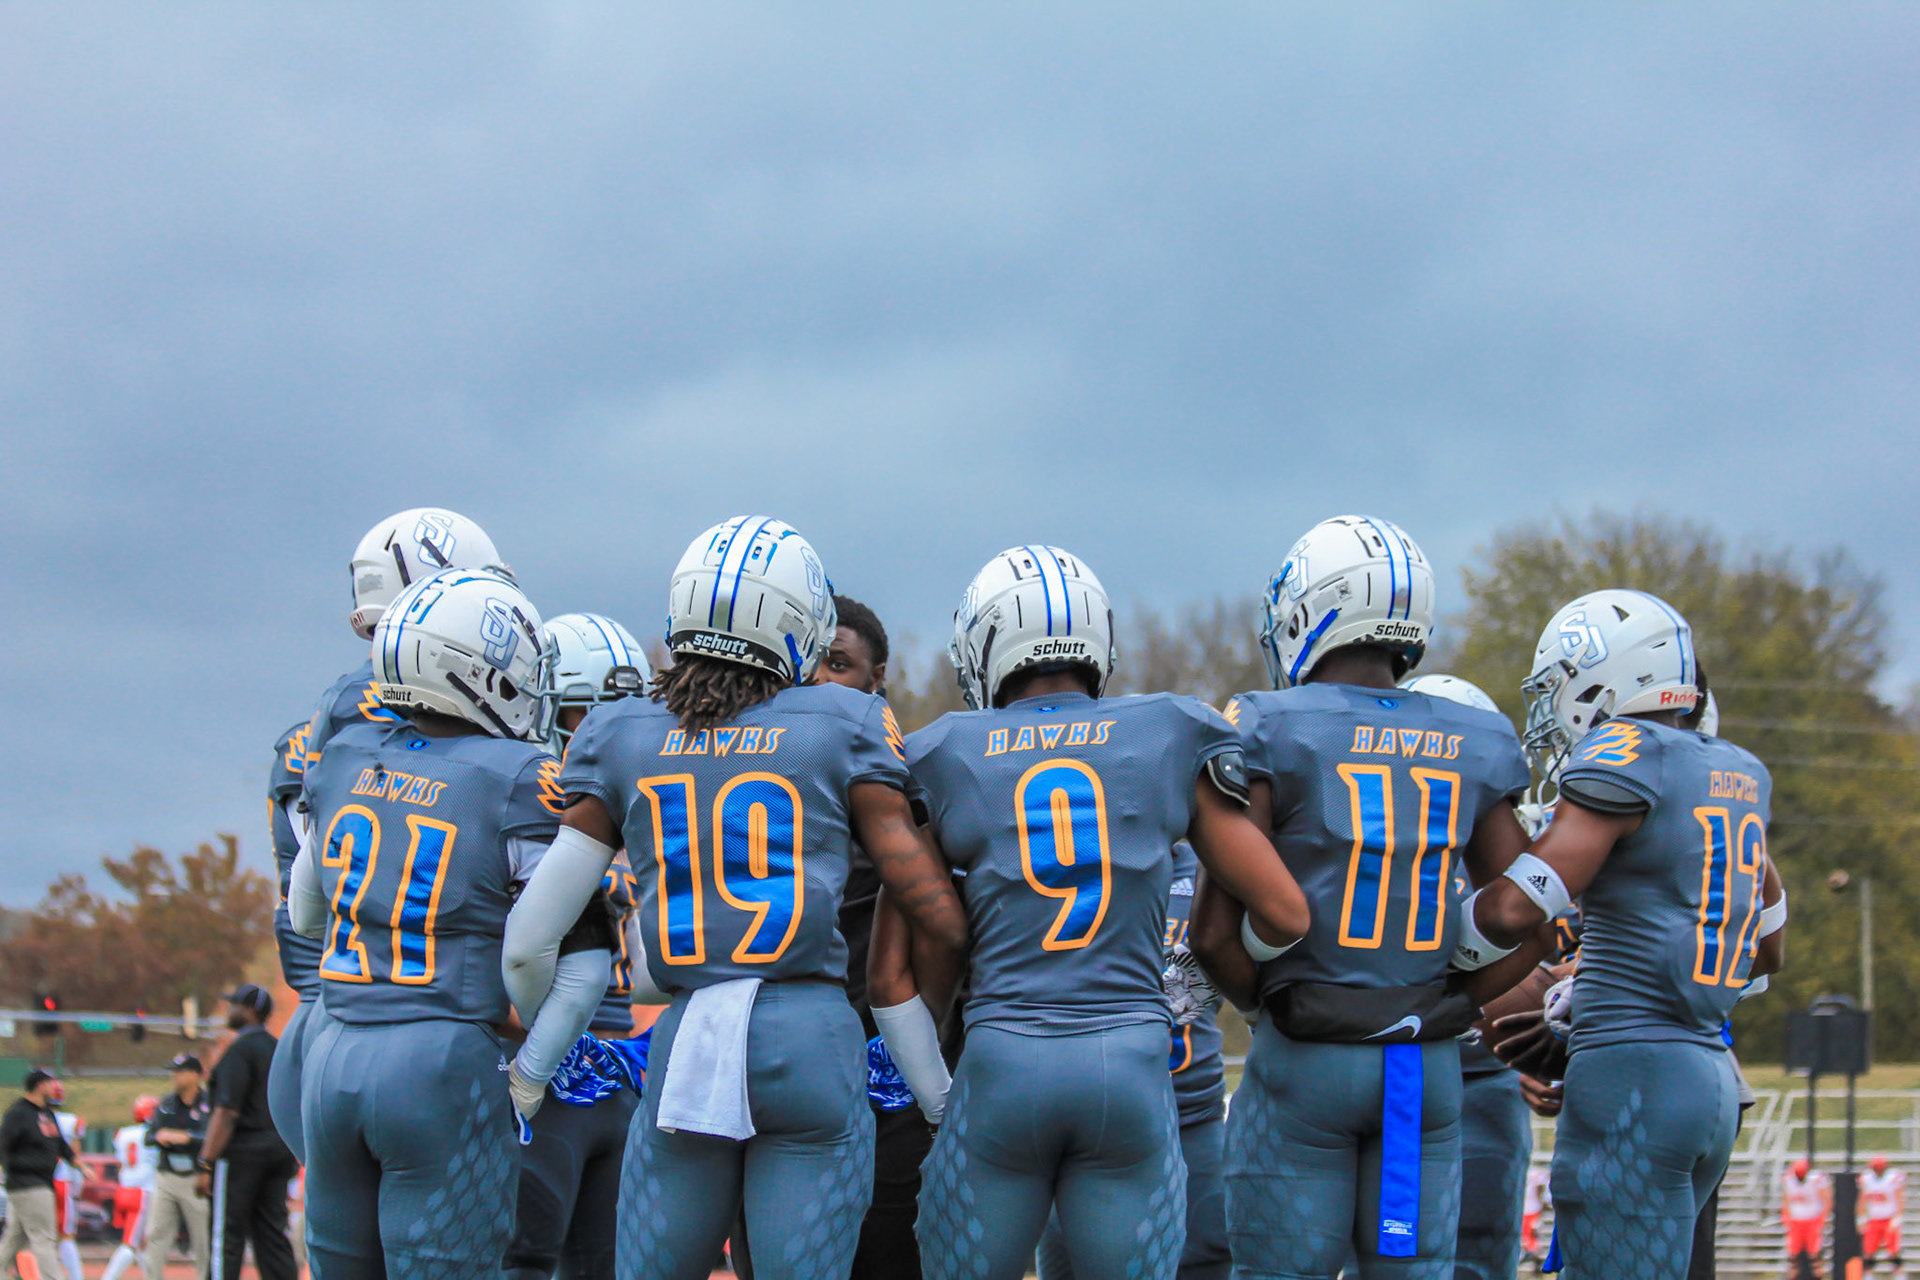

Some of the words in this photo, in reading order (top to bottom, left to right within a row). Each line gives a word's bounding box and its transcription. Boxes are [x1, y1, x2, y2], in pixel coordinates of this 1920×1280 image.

[692, 633, 749, 655] schutt
[1032, 638, 1086, 656] schutt
[1374, 621, 1421, 639] schutt
[382, 687, 412, 702] schutt
[659, 726, 787, 757] HAWKS
[985, 720, 1117, 757] HAWKS
[1350, 726, 1464, 760] HAWKS
[350, 768, 448, 808] HAWKS
[636, 771, 805, 966] 19
[1013, 758, 1112, 952] 9
[1336, 762, 1462, 952] 11
[318, 803, 458, 985] 21
[1692, 806, 1769, 989] 12
